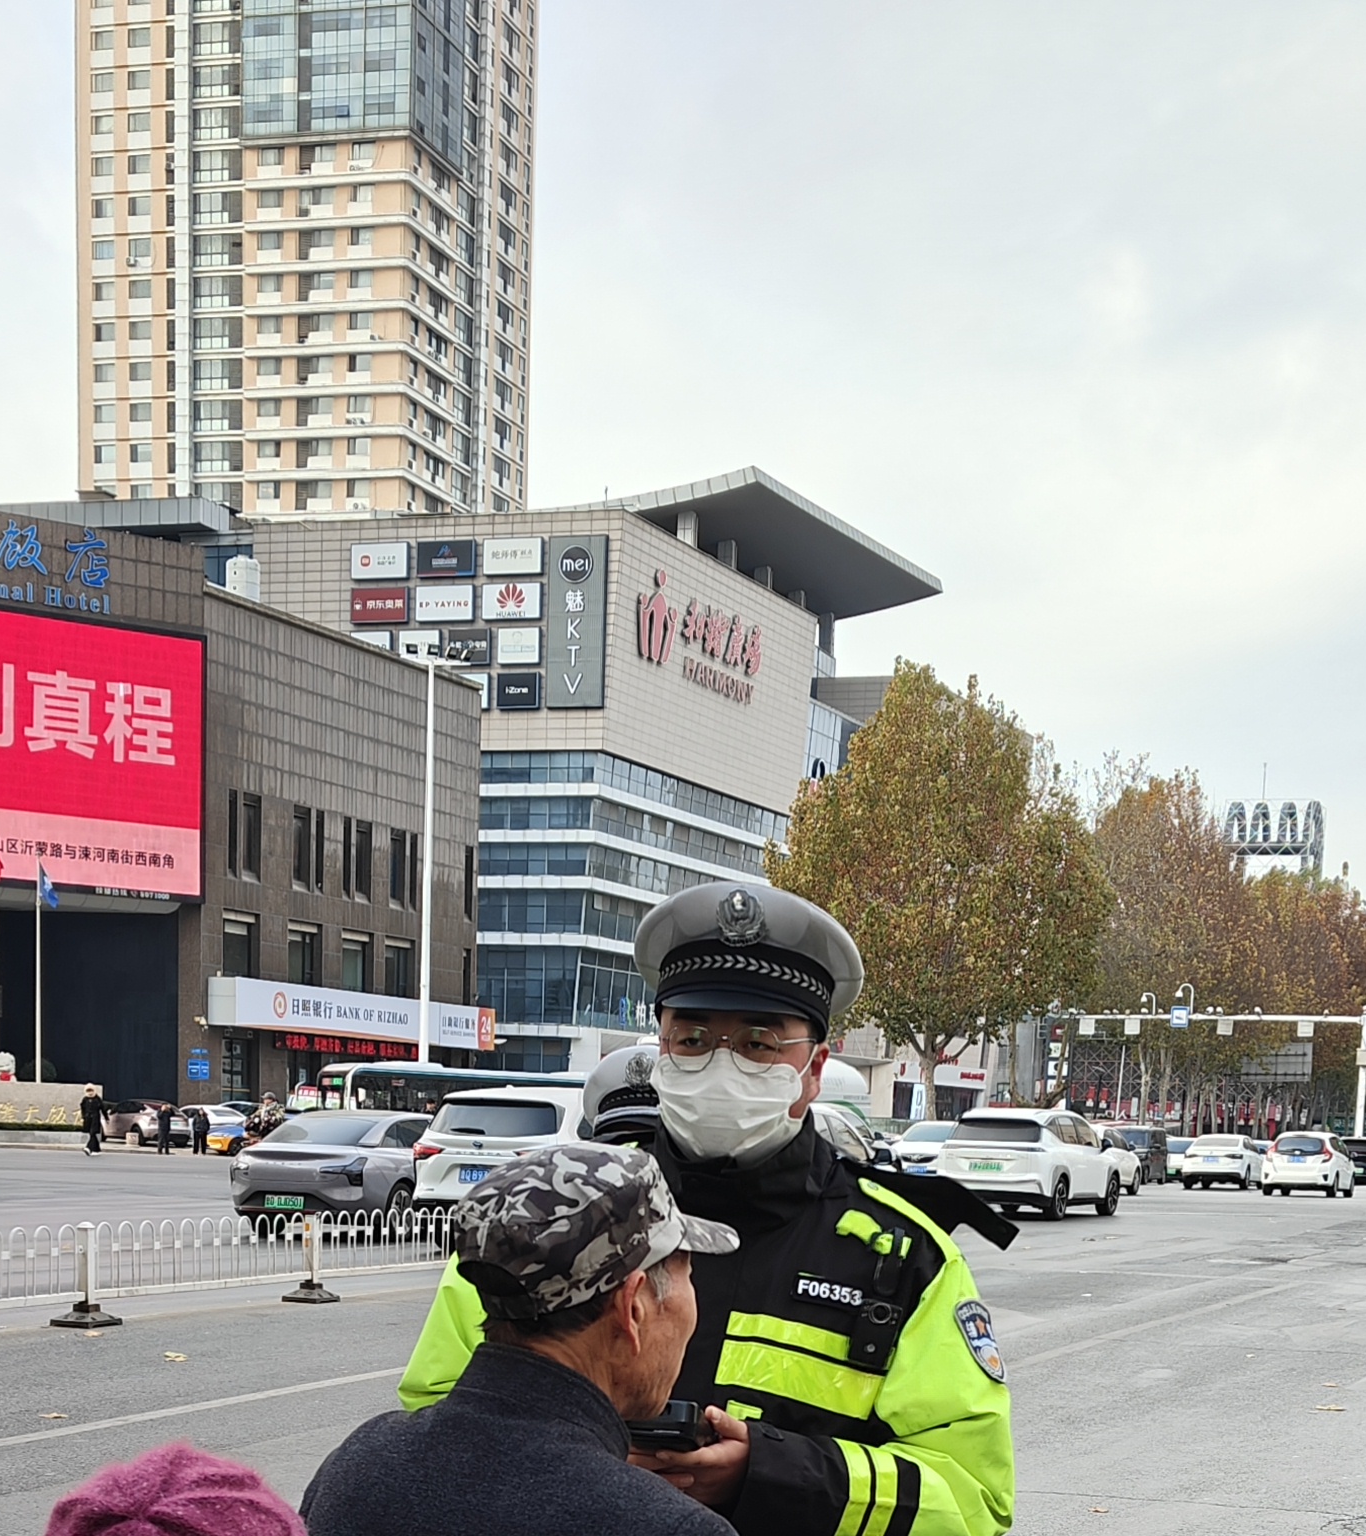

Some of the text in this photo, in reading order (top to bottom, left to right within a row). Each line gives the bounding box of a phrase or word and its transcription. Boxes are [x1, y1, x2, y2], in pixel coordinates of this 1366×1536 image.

[43, 585, 110, 615] Hotel
[366, 599, 404, 610] 京东奥莱
[434, 600, 469, 608] YAYING
[682, 656, 754, 704] HARMONY
[291, 998, 409, 1026] 日照银行 BANK OF RIZHAO
[481, 1015, 492, 1032] 24
[797, 1279, 863, 1306] F06353
